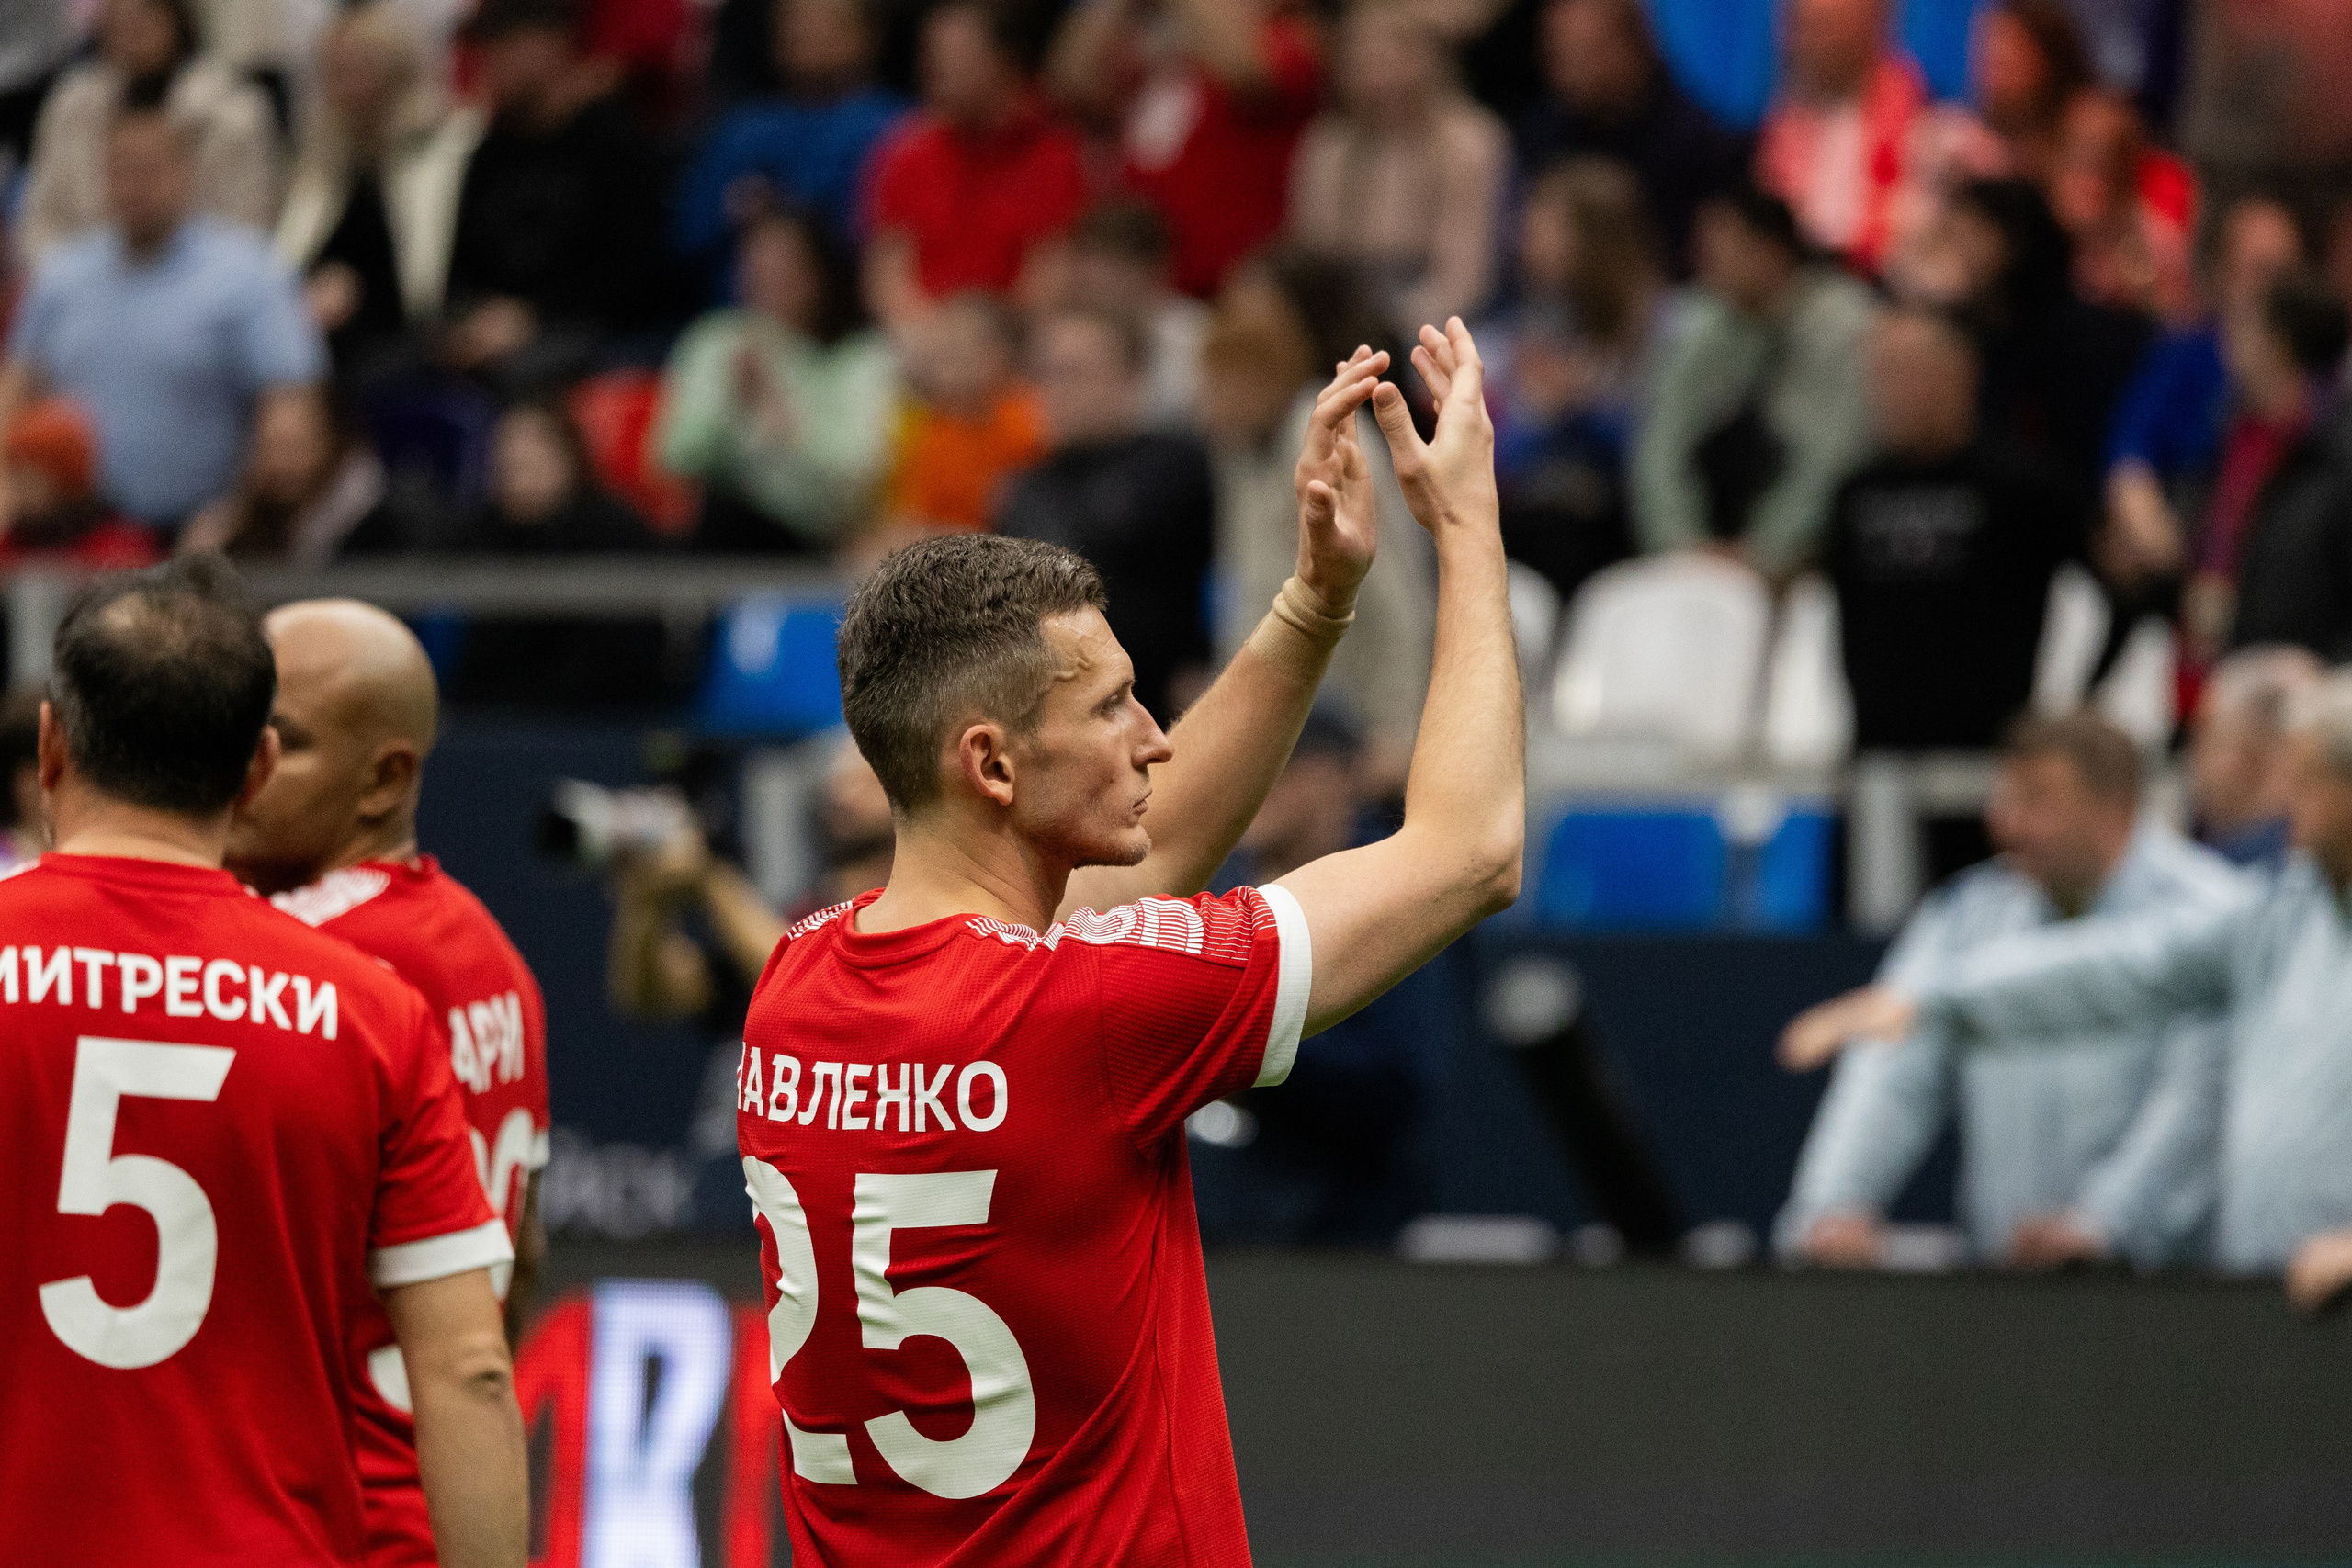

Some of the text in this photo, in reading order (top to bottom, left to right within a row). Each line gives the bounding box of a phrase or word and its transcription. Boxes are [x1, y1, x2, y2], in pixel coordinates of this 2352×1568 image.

[39, 1035, 236, 1370] 5
[736, 1041, 1009, 1133] АВЛЕНКО
[742, 1155, 1036, 1500] 25
